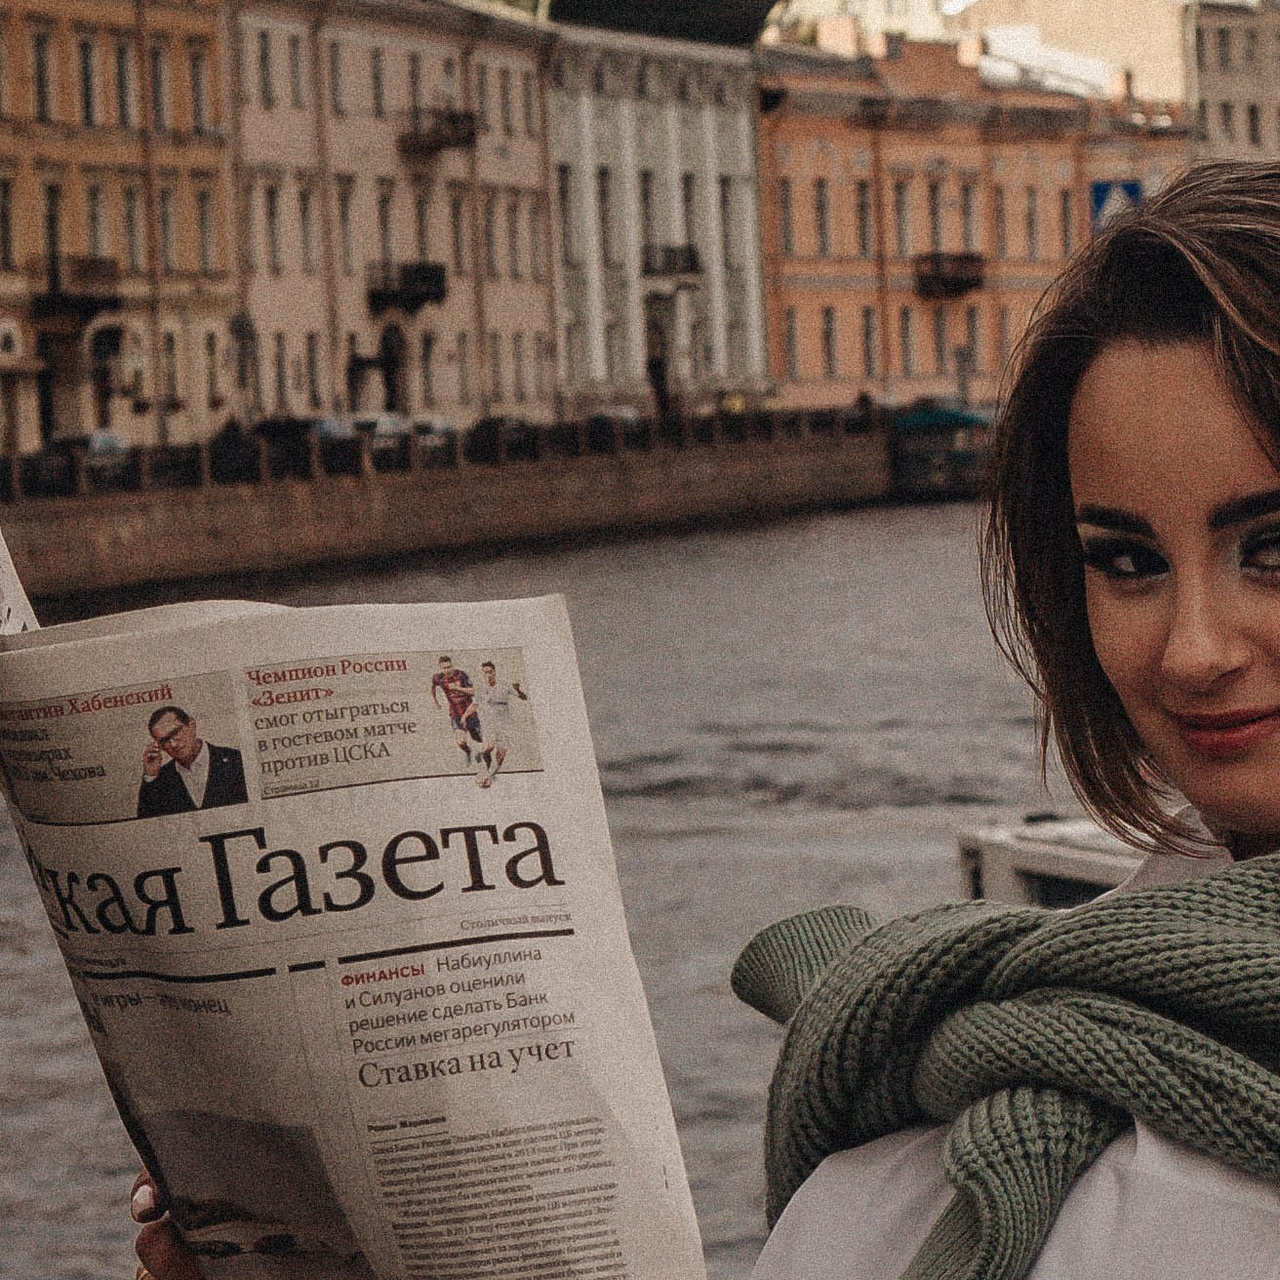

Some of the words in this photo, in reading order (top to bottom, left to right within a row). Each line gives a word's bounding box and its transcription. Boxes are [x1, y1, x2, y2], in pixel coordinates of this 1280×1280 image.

[247, 664, 336, 686] Чемпион
[340, 658, 407, 676] России
[68, 684, 173, 716] Хабенский
[251, 686, 334, 707] «Зенит»
[254, 712, 302, 730] смог
[302, 701, 410, 723] отыграться
[257, 740, 268, 752] в
[272, 728, 358, 750] гостевом
[363, 721, 417, 736] матче
[261, 753, 329, 776] против
[333, 742, 391, 764] ЦСКА
[198, 820, 565, 931] Газета
[341, 963, 425, 987] ФИНАНСЫ
[436, 948, 542, 972] Набиуллина
[345, 998, 356, 1009] и
[358, 984, 446, 1008] Силуанов
[450, 972, 526, 994] оценили
[349, 1009, 428, 1036] решение
[432, 998, 503, 1020] сделать
[506, 992, 549, 1009] Банк
[352, 1035, 417, 1055] России
[419, 1011, 575, 1045] мегарегулятором
[358, 1058, 463, 1089] Ставка
[469, 1050, 503, 1072] на
[507, 1040, 576, 1074] учет
